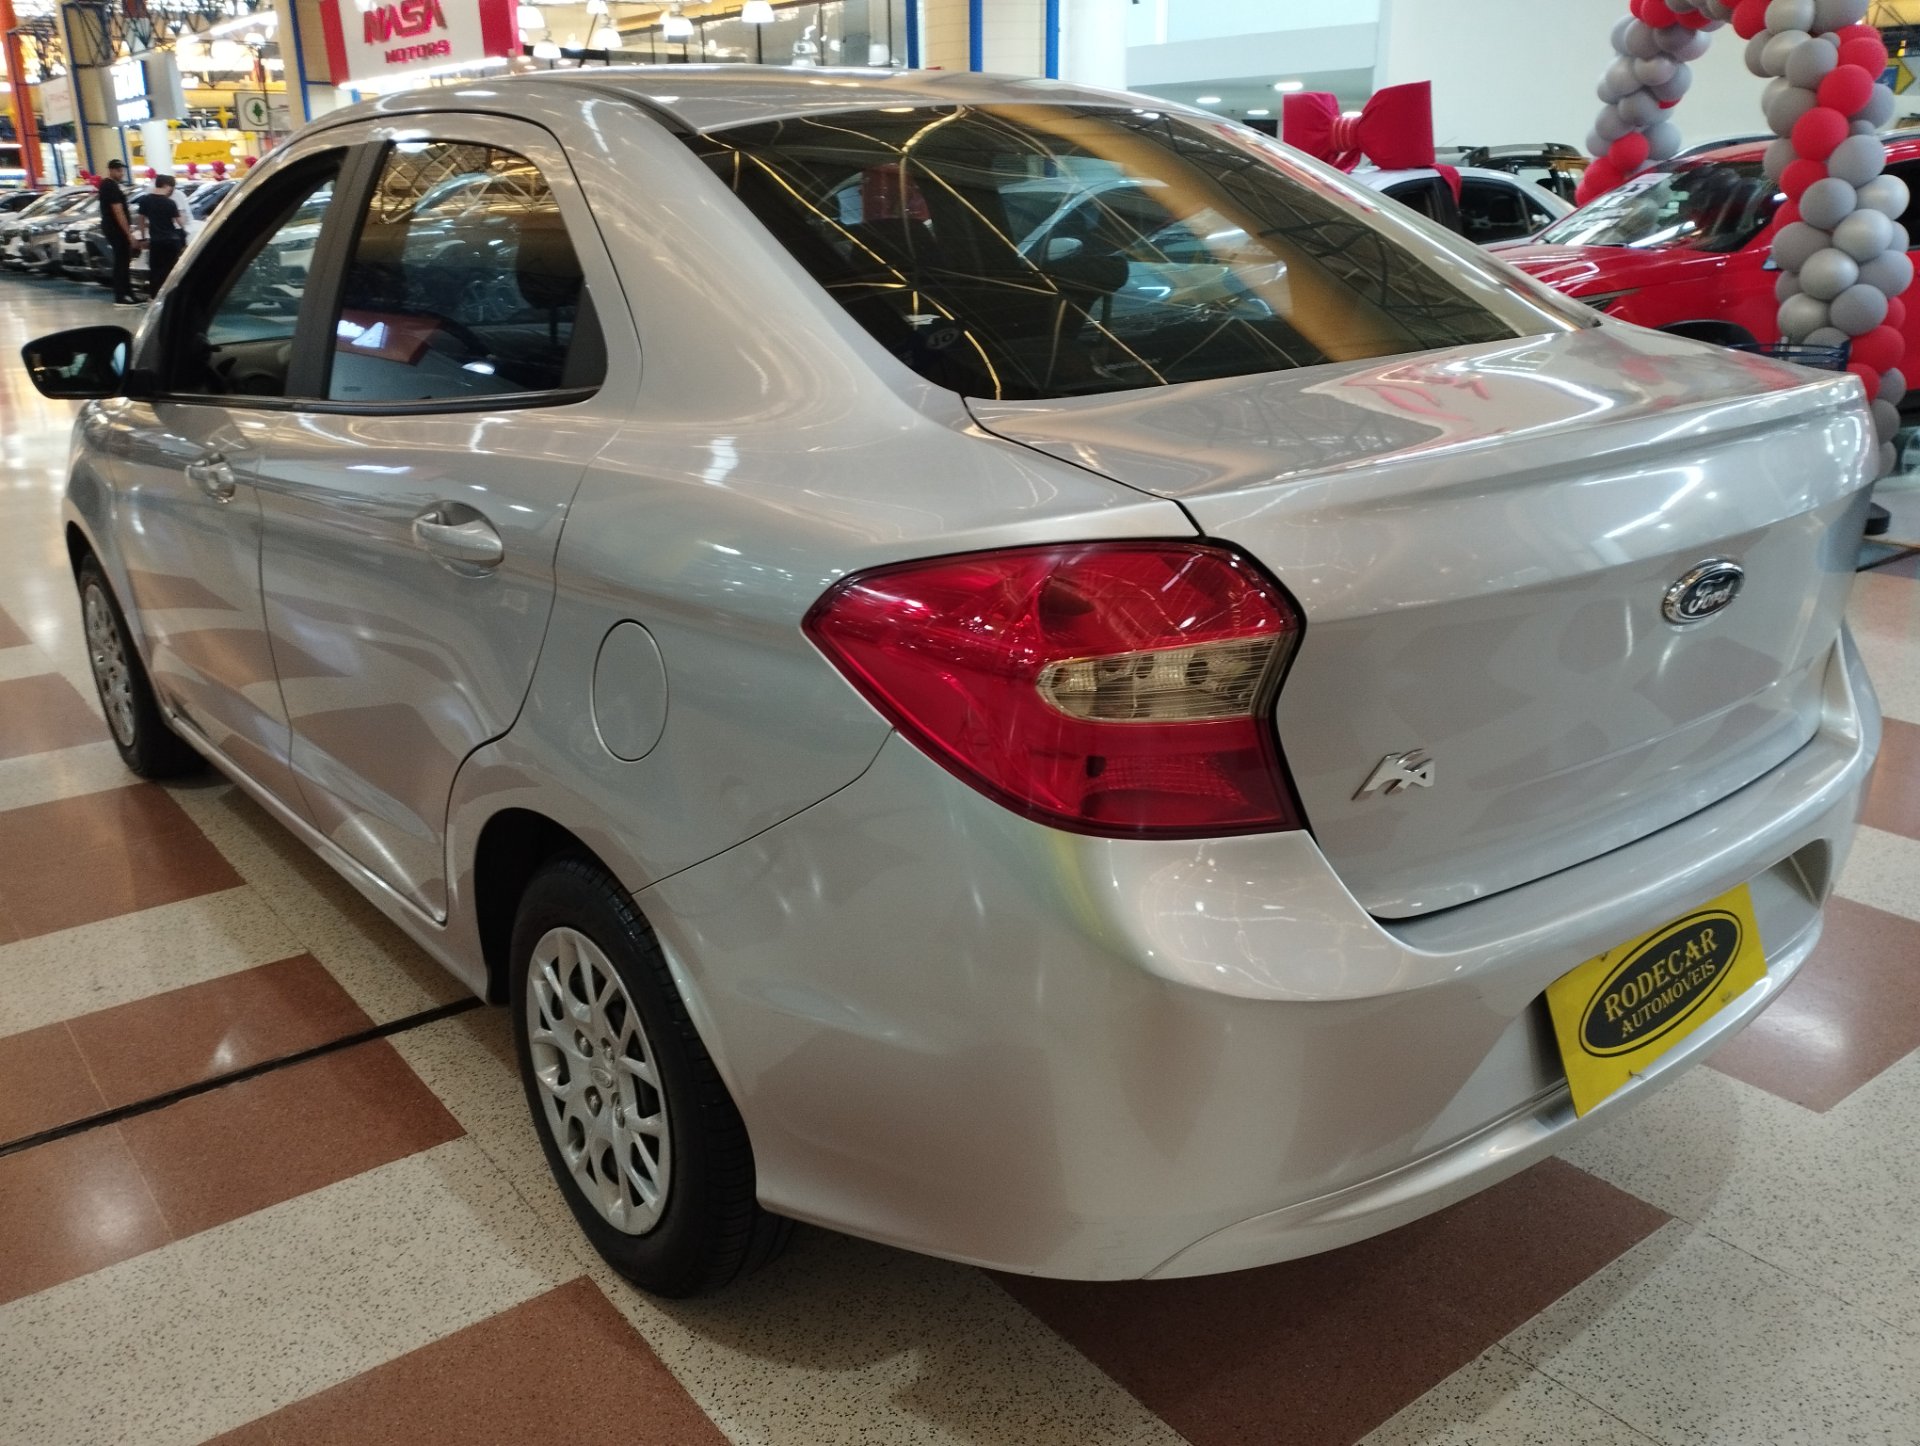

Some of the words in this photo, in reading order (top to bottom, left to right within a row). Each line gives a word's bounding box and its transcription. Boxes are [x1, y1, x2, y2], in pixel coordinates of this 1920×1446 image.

[364, 0, 447, 45] NASA
[385, 40, 450, 63] MOTORS
[1688, 577, 1734, 613] Ford
[1604, 928, 1718, 1022] RODECAR
[1622, 959, 1715, 1037] AUTOMÓVEIS
